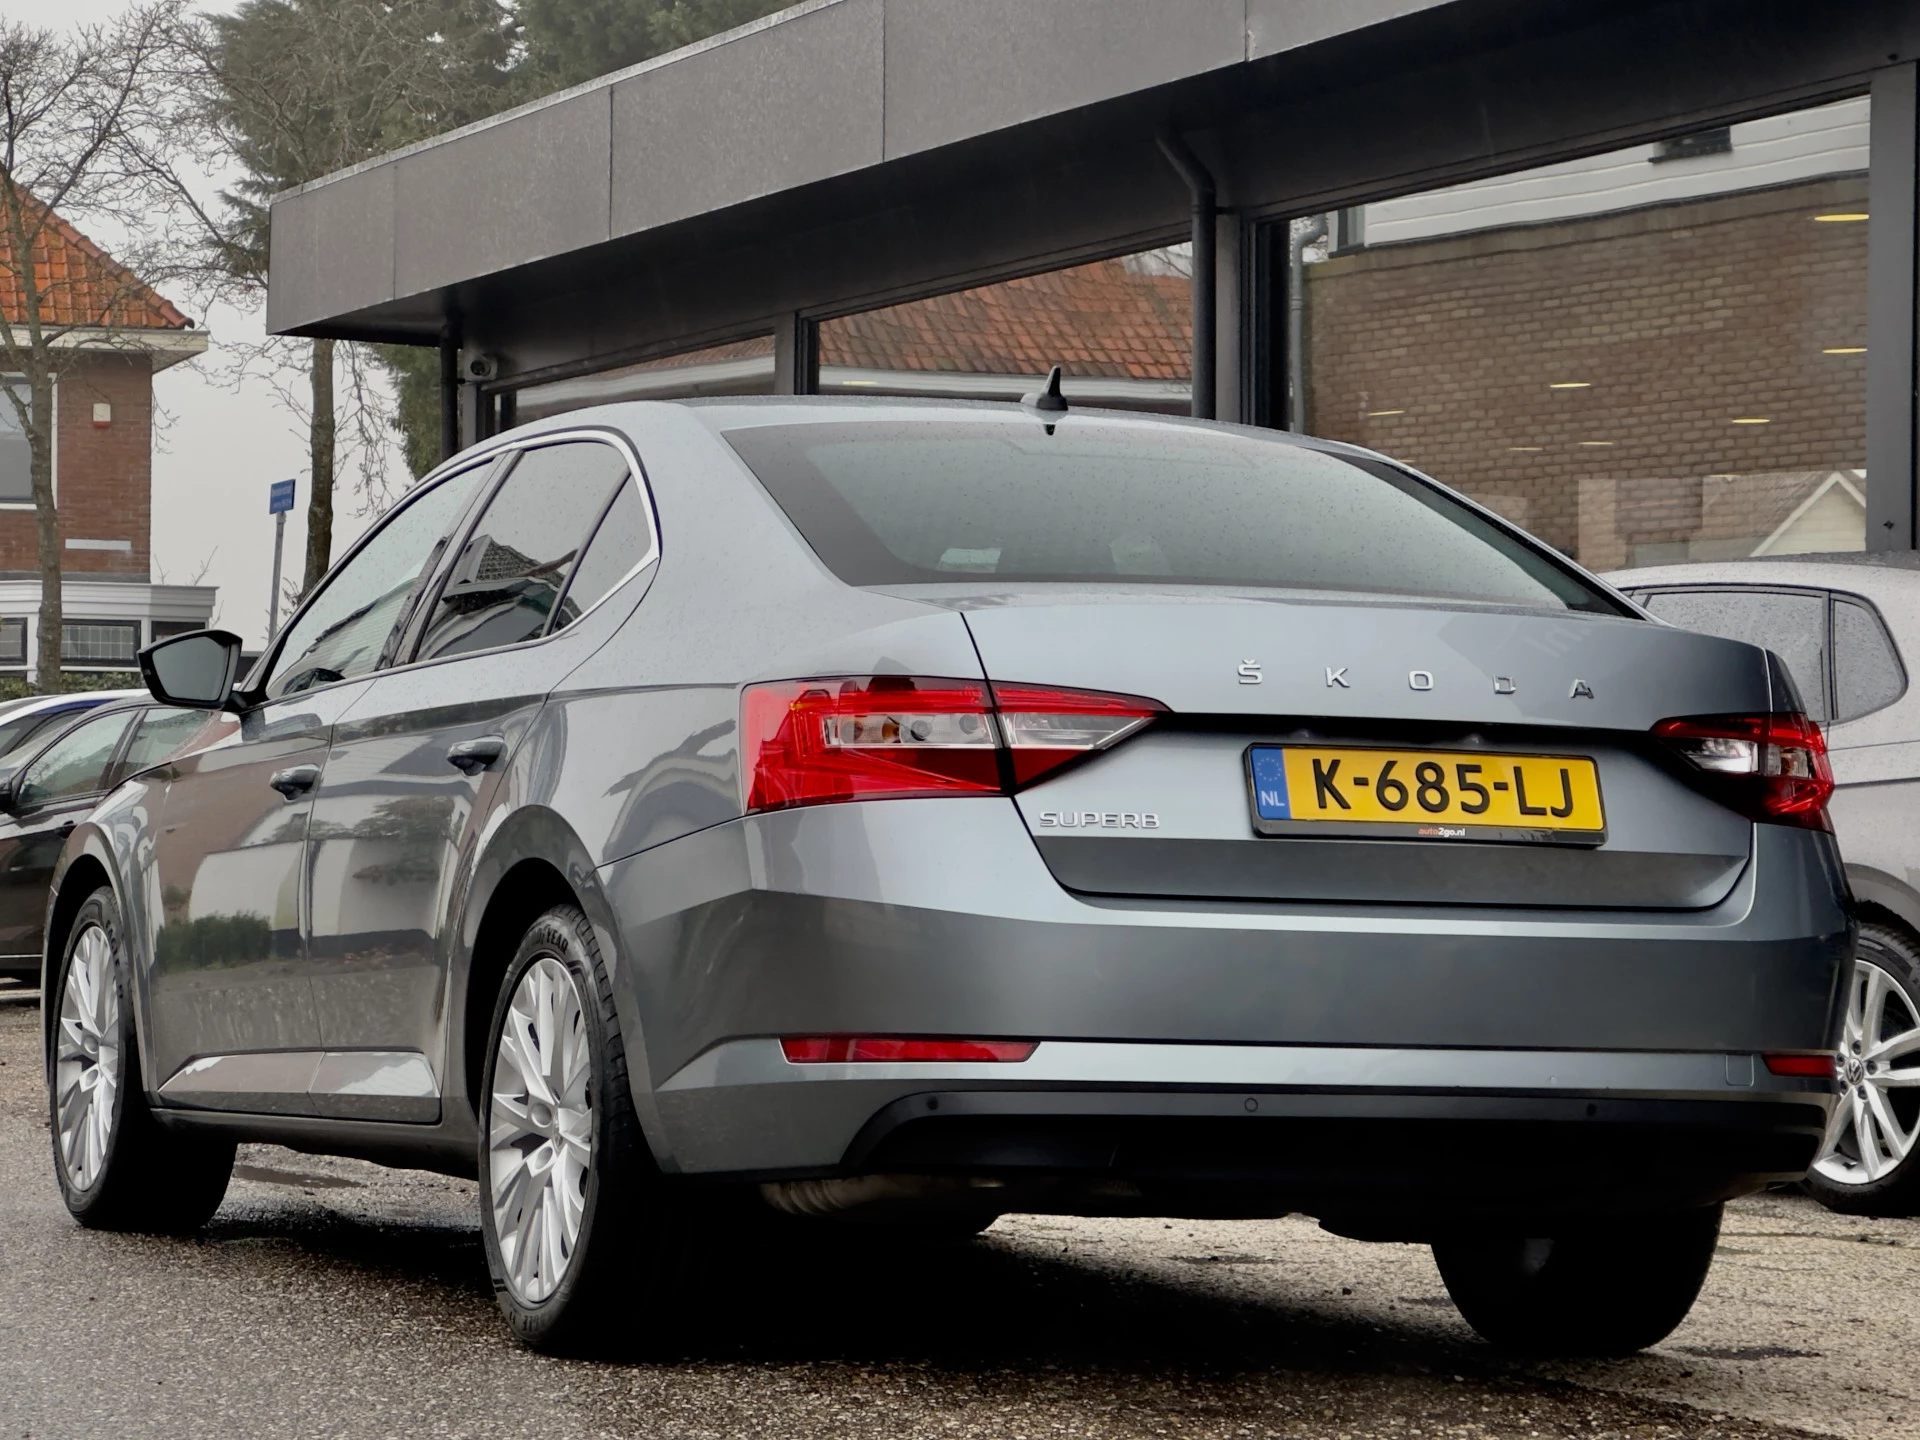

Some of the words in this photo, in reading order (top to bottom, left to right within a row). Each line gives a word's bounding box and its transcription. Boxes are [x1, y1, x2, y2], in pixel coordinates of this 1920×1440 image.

[1237, 659, 1594, 700] ŠKODA
[1260, 790, 1285, 807] NL
[1311, 758, 1574, 817] K-685-LJ
[1039, 811, 1161, 829] SUPERB
[1418, 827, 1466, 838] auto2go.nl
